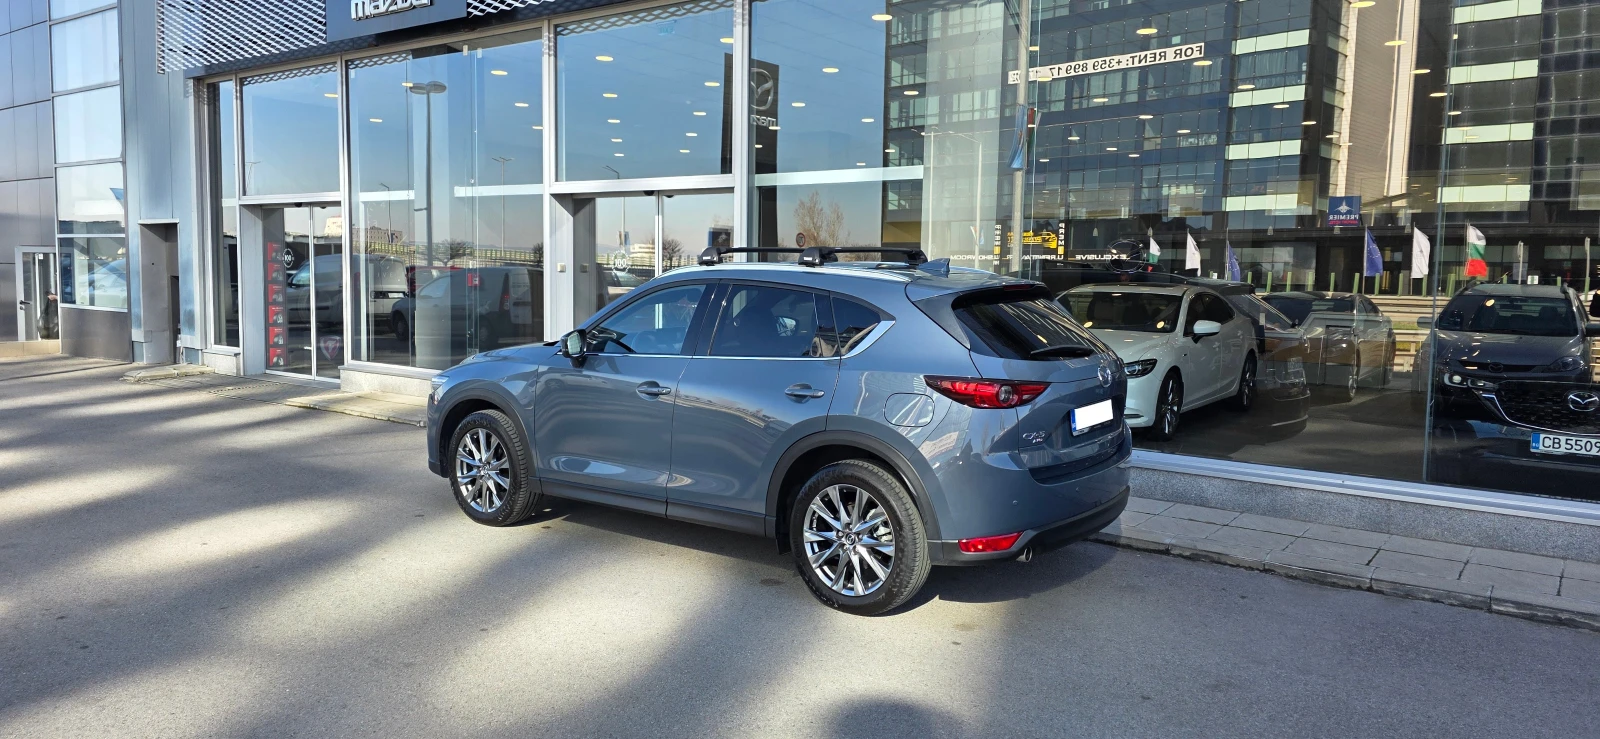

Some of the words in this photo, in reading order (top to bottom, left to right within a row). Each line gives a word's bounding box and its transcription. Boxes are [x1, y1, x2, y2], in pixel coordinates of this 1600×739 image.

[1022, 430, 1046, 439] CX-5
[1542, 436, 1562, 449] CB
[1565, 438, 1600, 453] 5509
